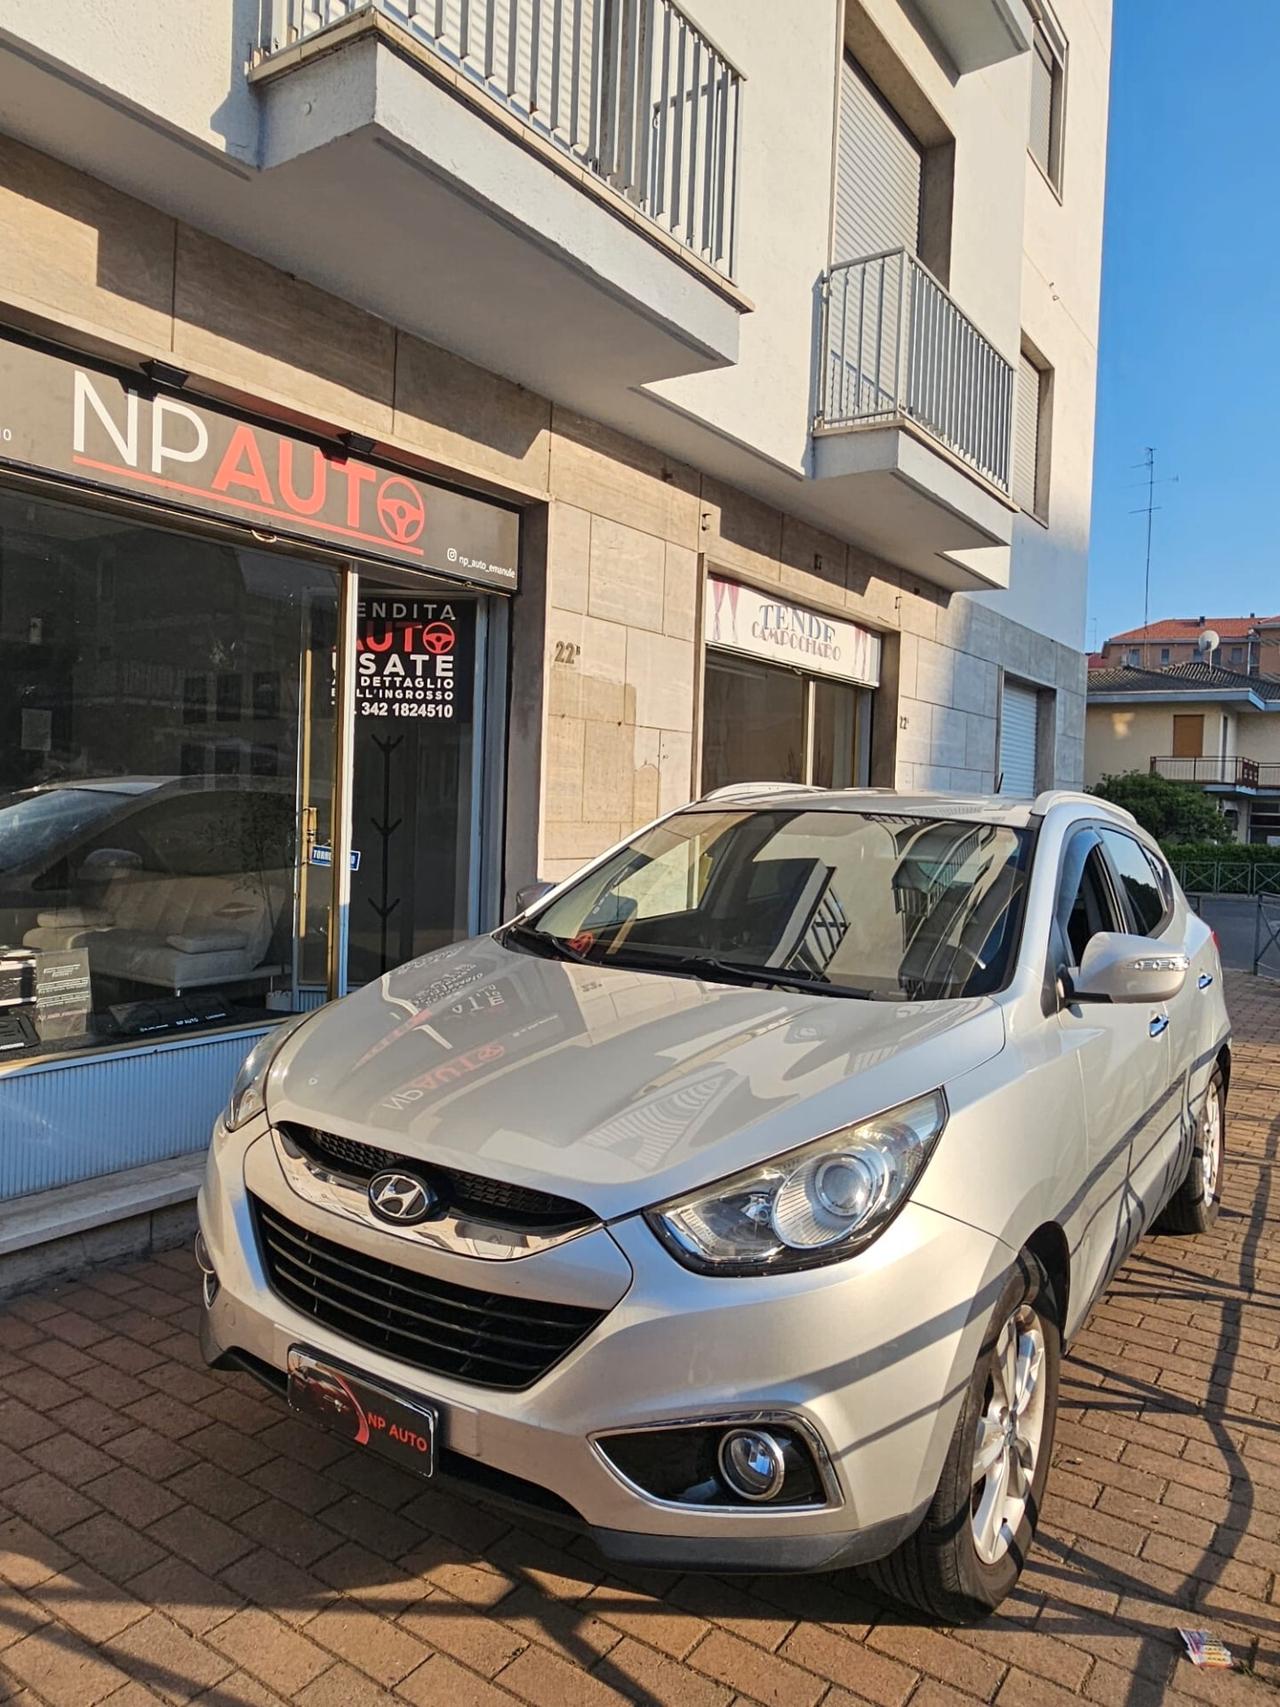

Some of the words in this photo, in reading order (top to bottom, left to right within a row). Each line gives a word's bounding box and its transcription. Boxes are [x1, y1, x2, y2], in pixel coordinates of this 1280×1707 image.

[0, 427, 12, 442] 0
[357, 602, 456, 620] ENDITA
[361, 676, 454, 689] DETTAGLIO
[356, 689, 454, 701] LL'INGROSSO
[361, 702, 388, 716] 342
[391, 703, 453, 718] 1824510
[368, 1411, 386, 1430] NP
[389, 1424, 427, 1452] AUTO
